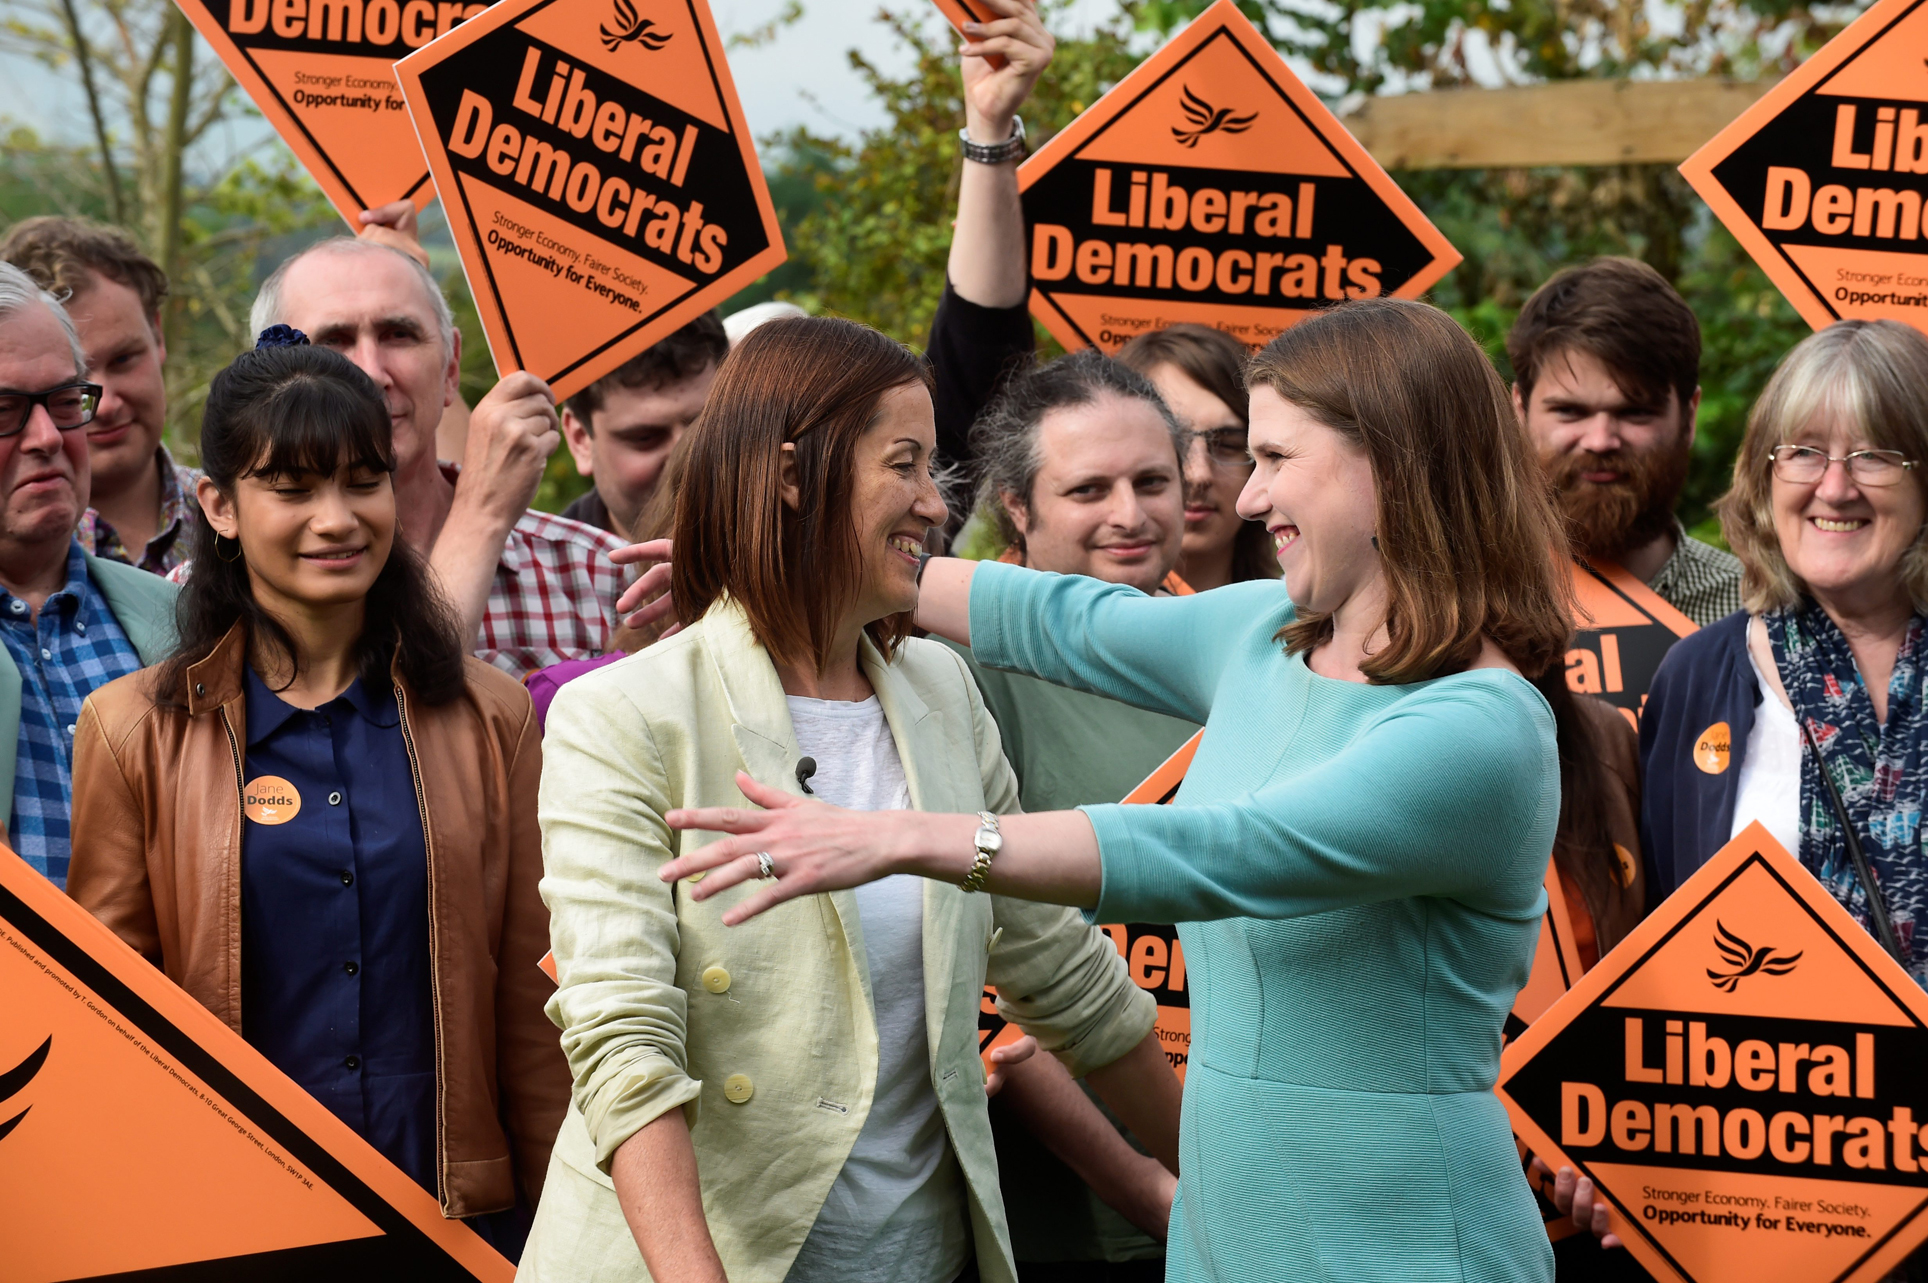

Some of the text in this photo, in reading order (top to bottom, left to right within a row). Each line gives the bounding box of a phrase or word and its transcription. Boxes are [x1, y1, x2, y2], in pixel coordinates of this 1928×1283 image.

[293, 90, 405, 112] Opportunity for
[294, 71, 342, 90] Stronger
[513, 45, 698, 188] Liberal
[448, 88, 728, 275] Democrats
[1092, 168, 1316, 239] Liberal
[1762, 166, 1928, 241] Dem
[487, 229, 642, 314] Opportunity for Everyone.
[492, 210, 648, 296] Stronger Economy. Fairer Society.
[1031, 223, 1383, 300] Democrats
[1836, 267, 1893, 287] Stronger
[1101, 314, 1151, 329] Stronger
[1701, 741, 1730, 752] Dodds
[247, 795, 293, 806] Dodds
[255, 783, 284, 796] Jane
[6, 936, 36, 961] Published
[33, 959, 47, 970] and
[44, 968, 75, 993] promoted
[72, 989, 82, 1000] by
[80, 996, 87, 1004] T.
[86, 1001, 109, 1021] Gordon
[107, 1019, 116, 1028] on
[115, 1024, 136, 1042] behalf
[133, 1040, 142, 1048] of
[139, 1044, 151, 1056] the
[149, 1052, 171, 1072] Liberal
[168, 1068, 199, 1097] Democrats,
[199, 1093, 213, 1106] 8-10
[211, 1103, 228, 1120] Great
[226, 1116, 248, 1135] George
[246, 1132, 264, 1151] Street,
[264, 1147, 286, 1169] London,
[286, 1165, 303, 1180] SW1P
[301, 1178, 314, 1191] 3AE.
[1625, 1017, 1875, 1099] Liberal
[1642, 1186, 1871, 1218] Stronger Economy. Fairer Society.
[1643, 1204, 1871, 1238] Opportunity for Everyone.
